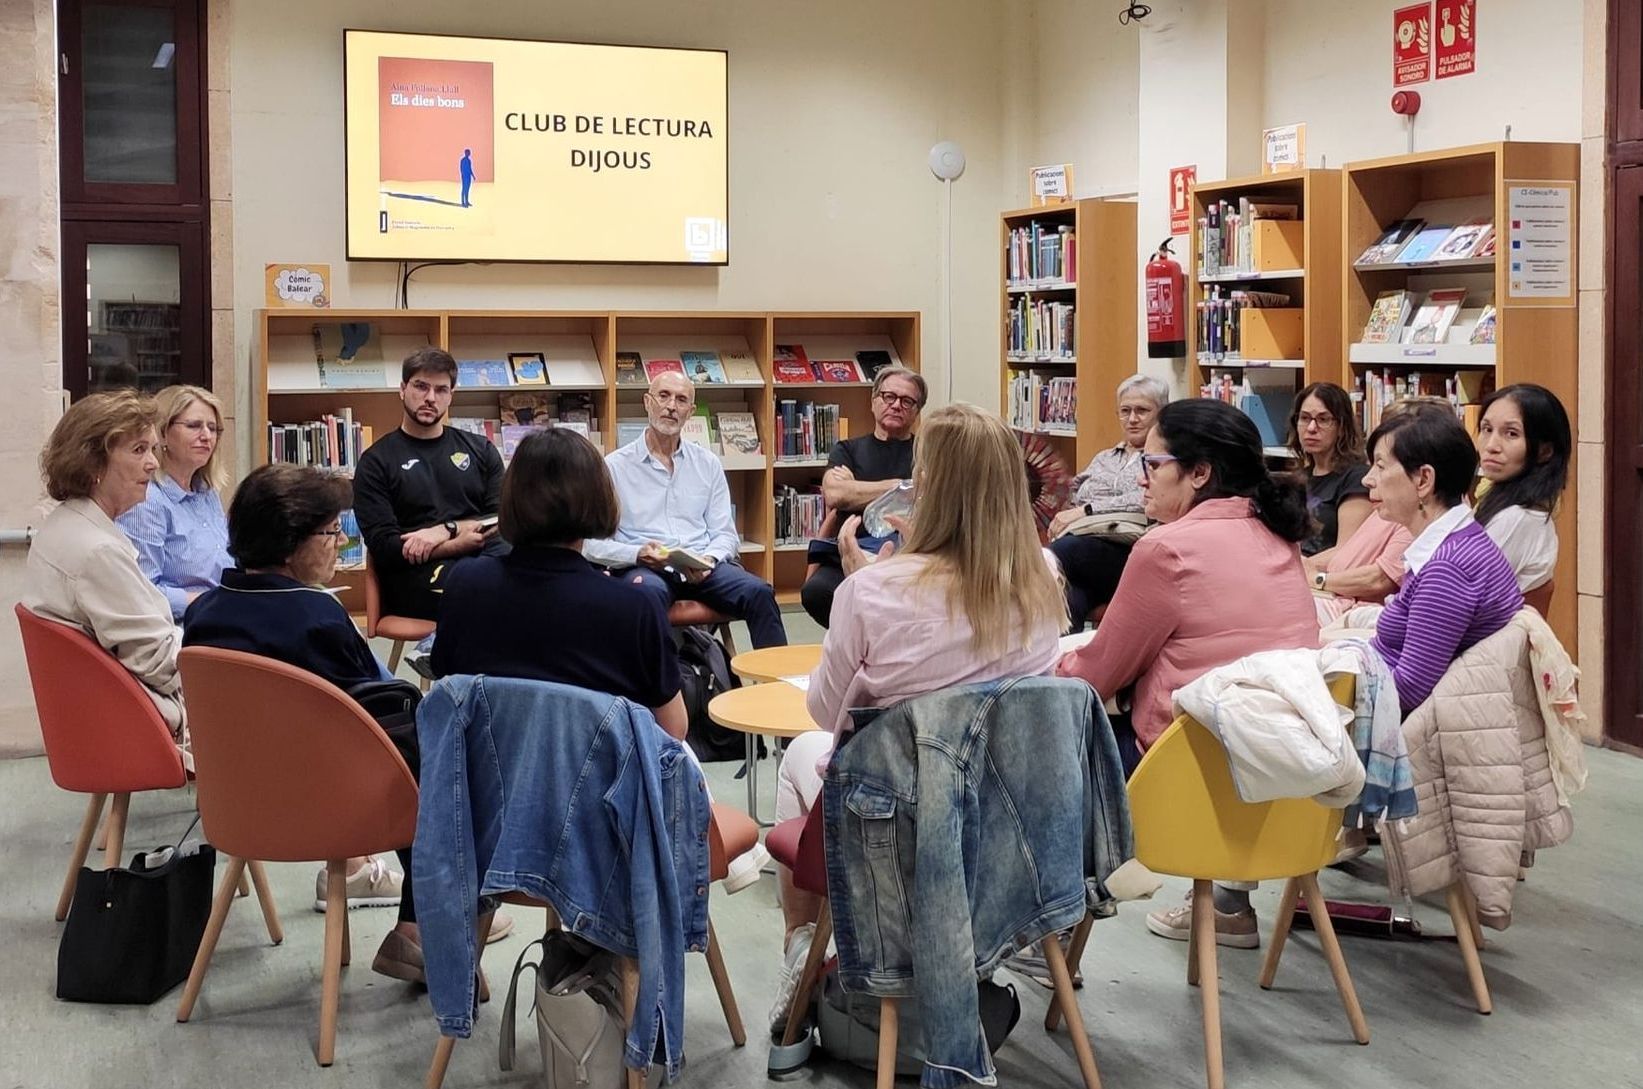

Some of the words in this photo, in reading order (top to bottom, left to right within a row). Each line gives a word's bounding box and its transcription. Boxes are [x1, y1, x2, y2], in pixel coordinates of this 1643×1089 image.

[1439, 51, 1471, 65] PULSADOR
[1397, 61, 1427, 74] AVISADOR
[1438, 66, 1448, 75] DE
[1448, 60, 1472, 73] ALARMA
[1399, 71, 1425, 83] SONORO
[391, 93, 409, 106] Els
[411, 94, 435, 107] dies
[437, 95, 465, 108] bons
[505, 112, 567, 133] CLUB
[575, 115, 604, 134] DE
[612, 117, 713, 139] LECTURA
[570, 149, 651, 172] DIJOUS
[287, 284, 313, 293] Balear
